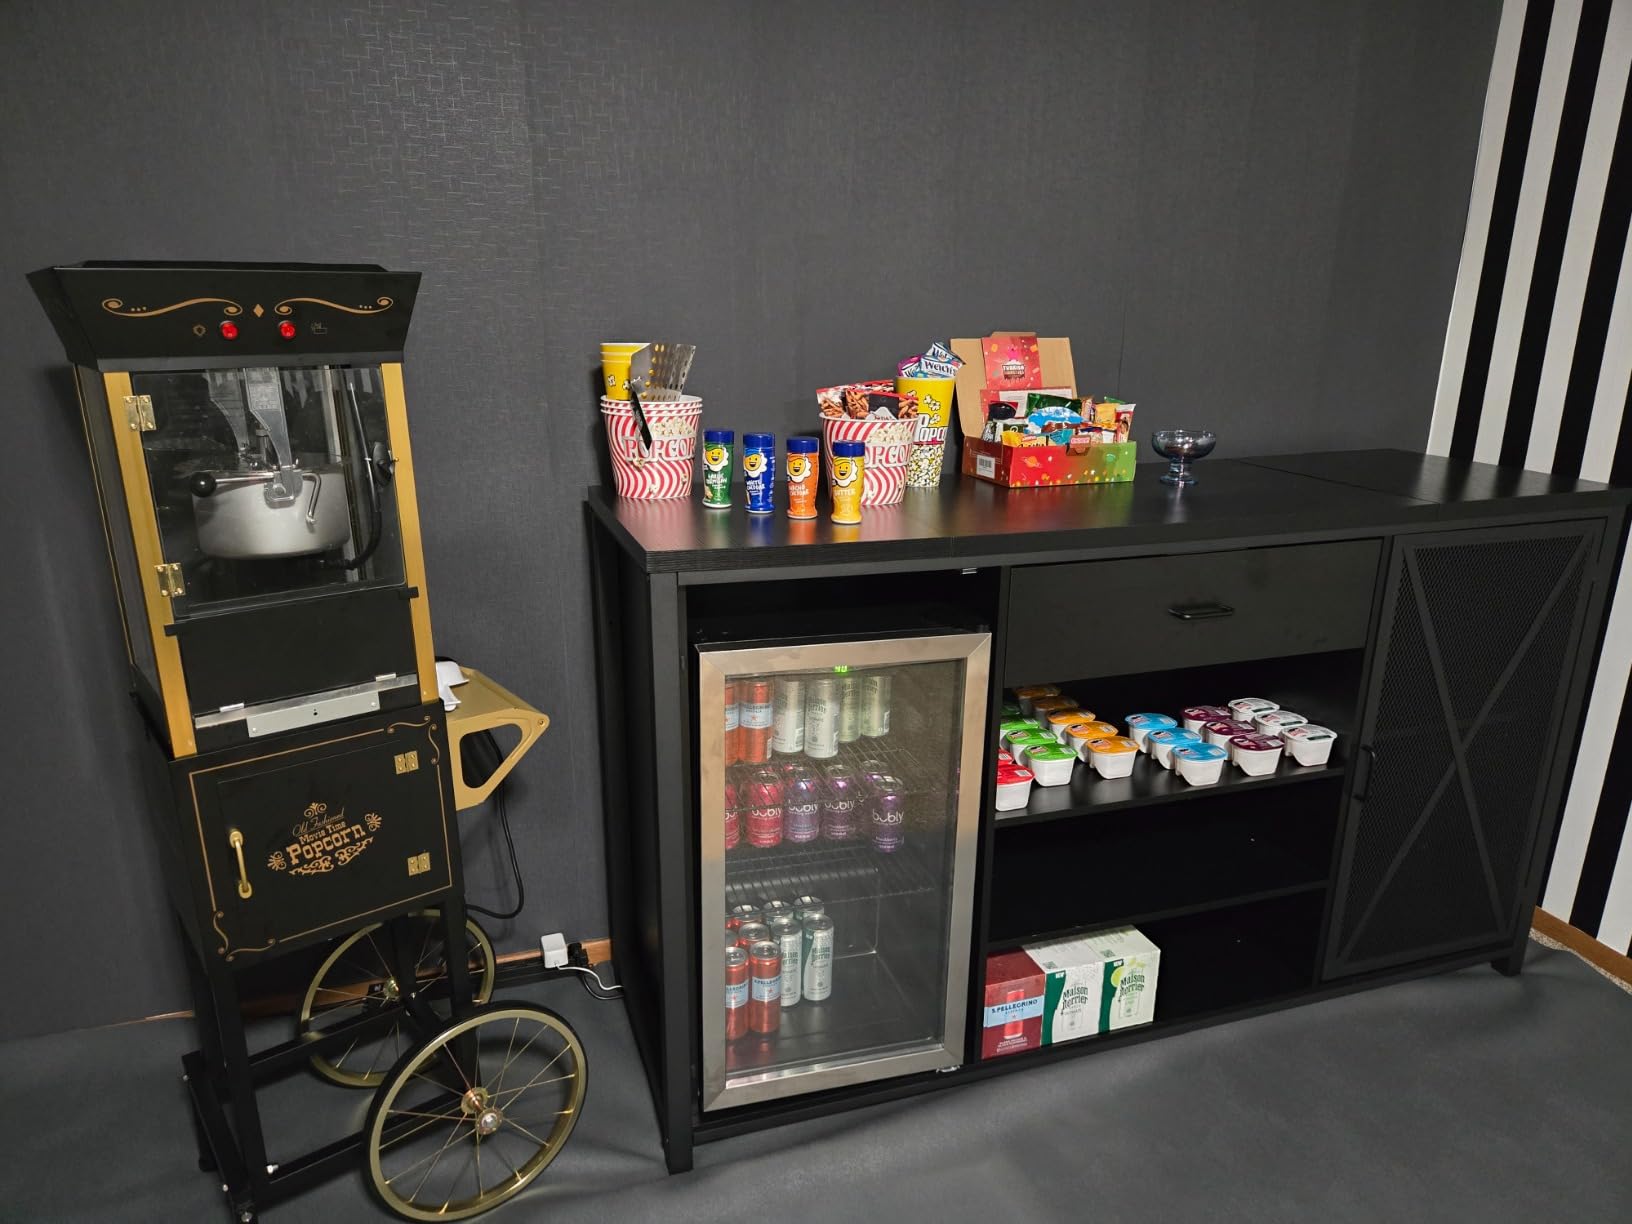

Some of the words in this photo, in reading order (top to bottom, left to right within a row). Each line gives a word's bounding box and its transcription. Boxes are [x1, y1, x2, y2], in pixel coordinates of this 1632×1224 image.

[299, 830, 326, 845] Movie
[326, 821, 347, 834] Time
[286, 824, 366, 865] Popcorn
[1120, 974, 1145, 986] Maison
[1062, 986, 1089, 999] Maison
